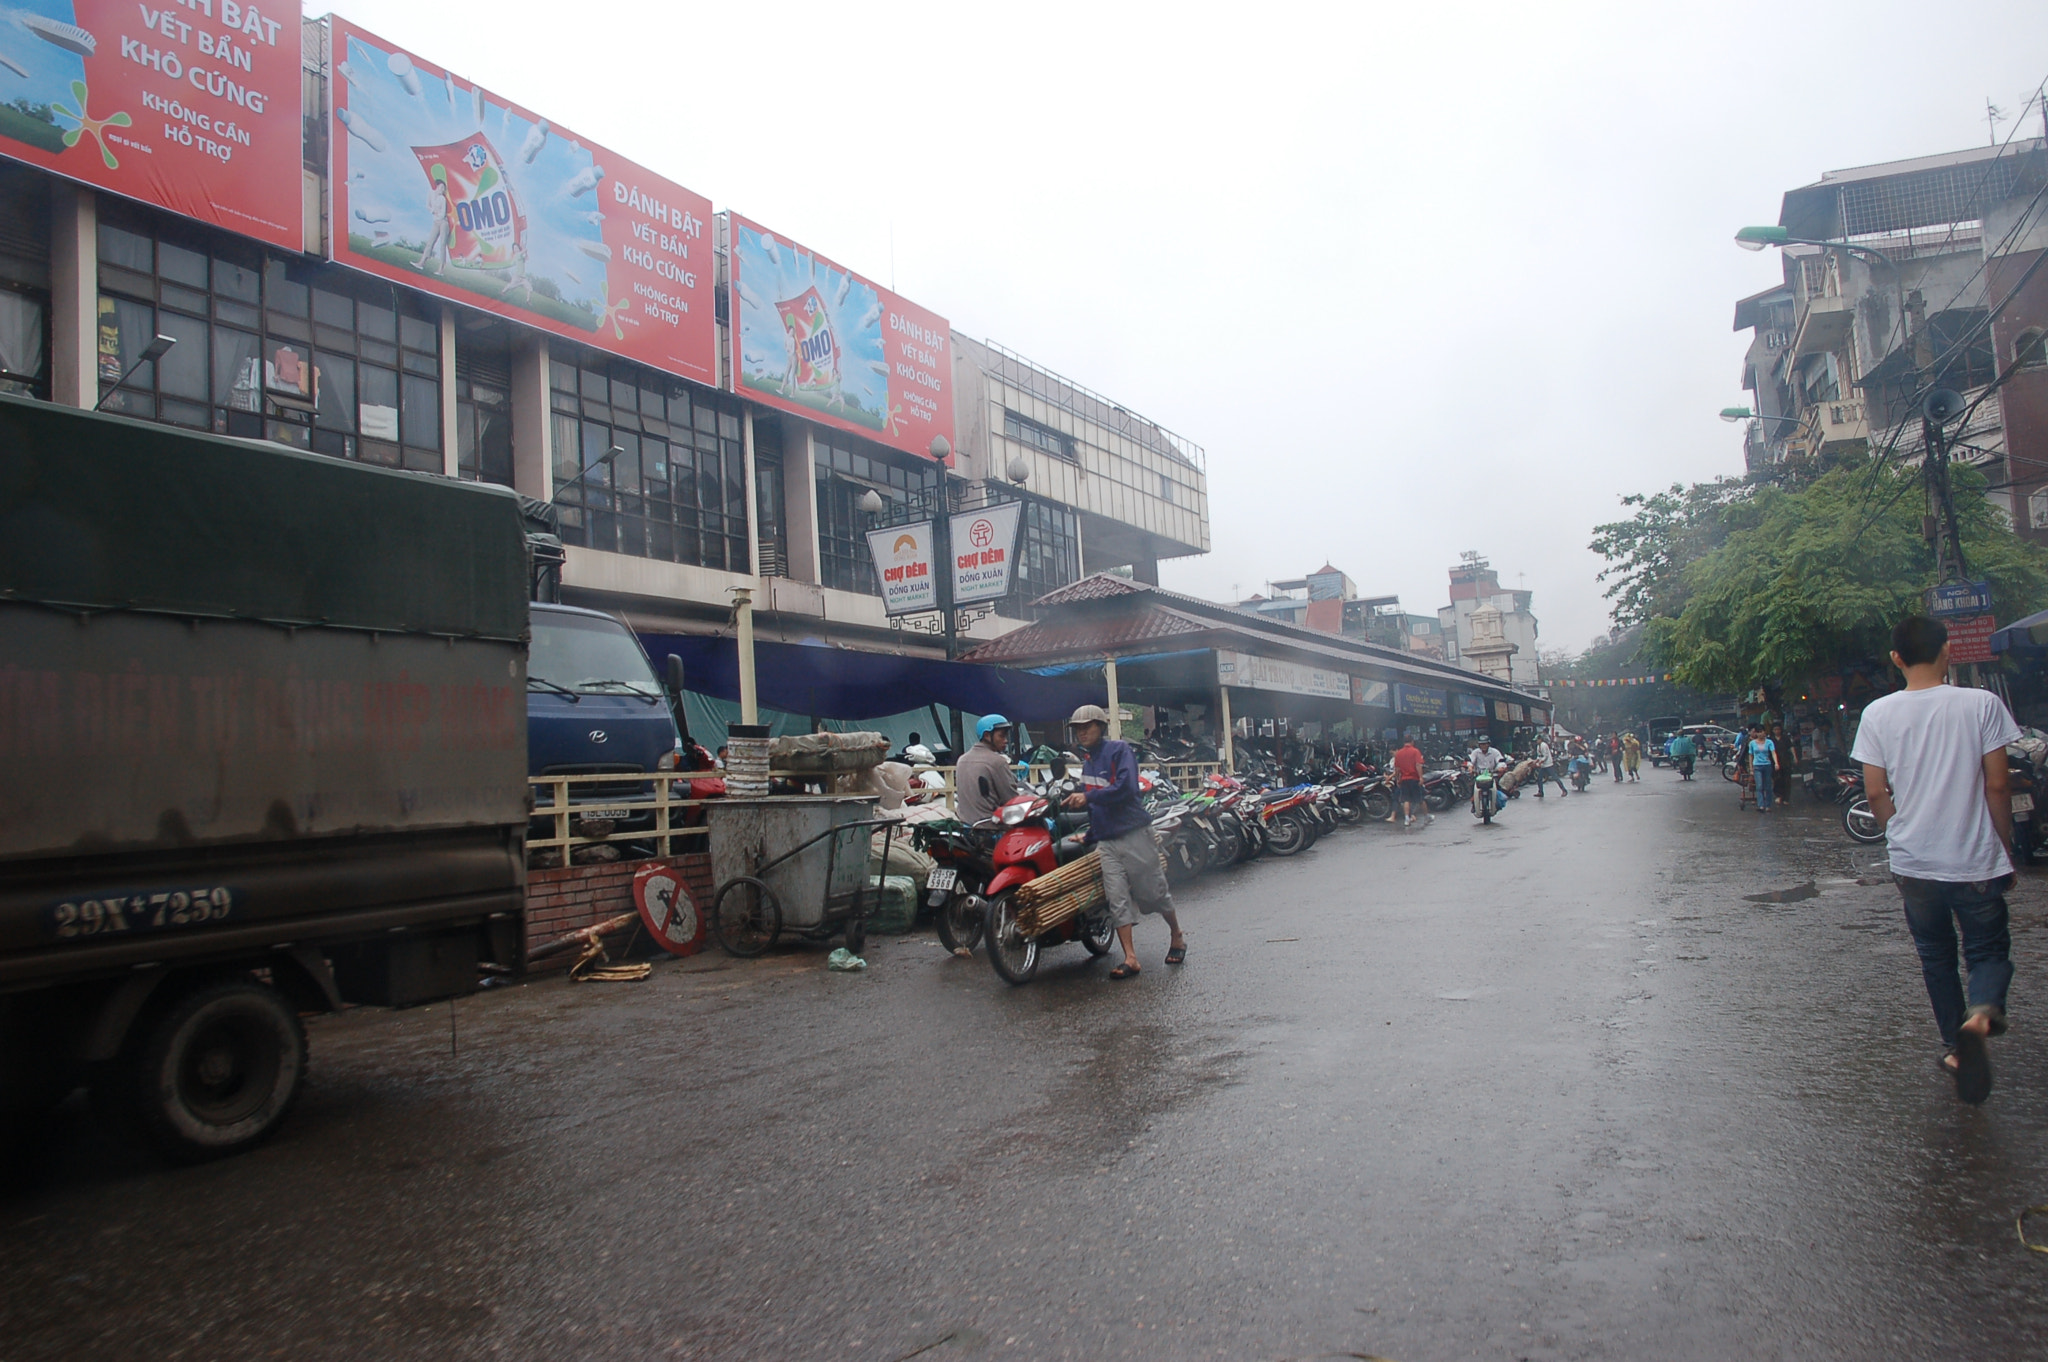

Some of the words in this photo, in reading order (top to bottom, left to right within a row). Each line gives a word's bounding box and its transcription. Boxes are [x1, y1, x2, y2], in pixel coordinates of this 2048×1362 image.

[139, 3, 192, 45] VẾT
[198, 30, 252, 73] BẨN
[222, 0, 282, 47] BẬT
[121, 35, 183, 79] KHÔ
[142, 90, 210, 131] KHÔNG
[214, 120, 250, 147] CẦN
[164, 123, 193, 146] HỖ
[195, 135, 232, 164] TRỢ
[456, 191, 511, 232] OMO
[613, 181, 668, 225] ĐÁNH
[671, 207, 703, 240] BẬT
[631, 220, 658, 246] VẾT
[660, 233, 689, 260] BẨN
[623, 244, 654, 271] KHÔ
[633, 281, 668, 305] KHÔNG
[644, 303, 660, 318] HỖ
[660, 309, 679, 328] TRỢ
[801, 329, 831, 363] OMO
[889, 312, 923, 343] ĐÁNH
[924, 329, 945, 354] BẬT
[900, 342, 918, 361] VẾT
[896, 361, 916, 381] KHÔ
[903, 390, 925, 407] KHÔNG
[884, 565, 904, 583] CHỢ
[906, 561, 928, 578] ĐÊM
[957, 551, 979, 570] CHỢ
[981, 547, 1005, 565] ĐÊM
[979, 580, 1003, 589] MARKET
